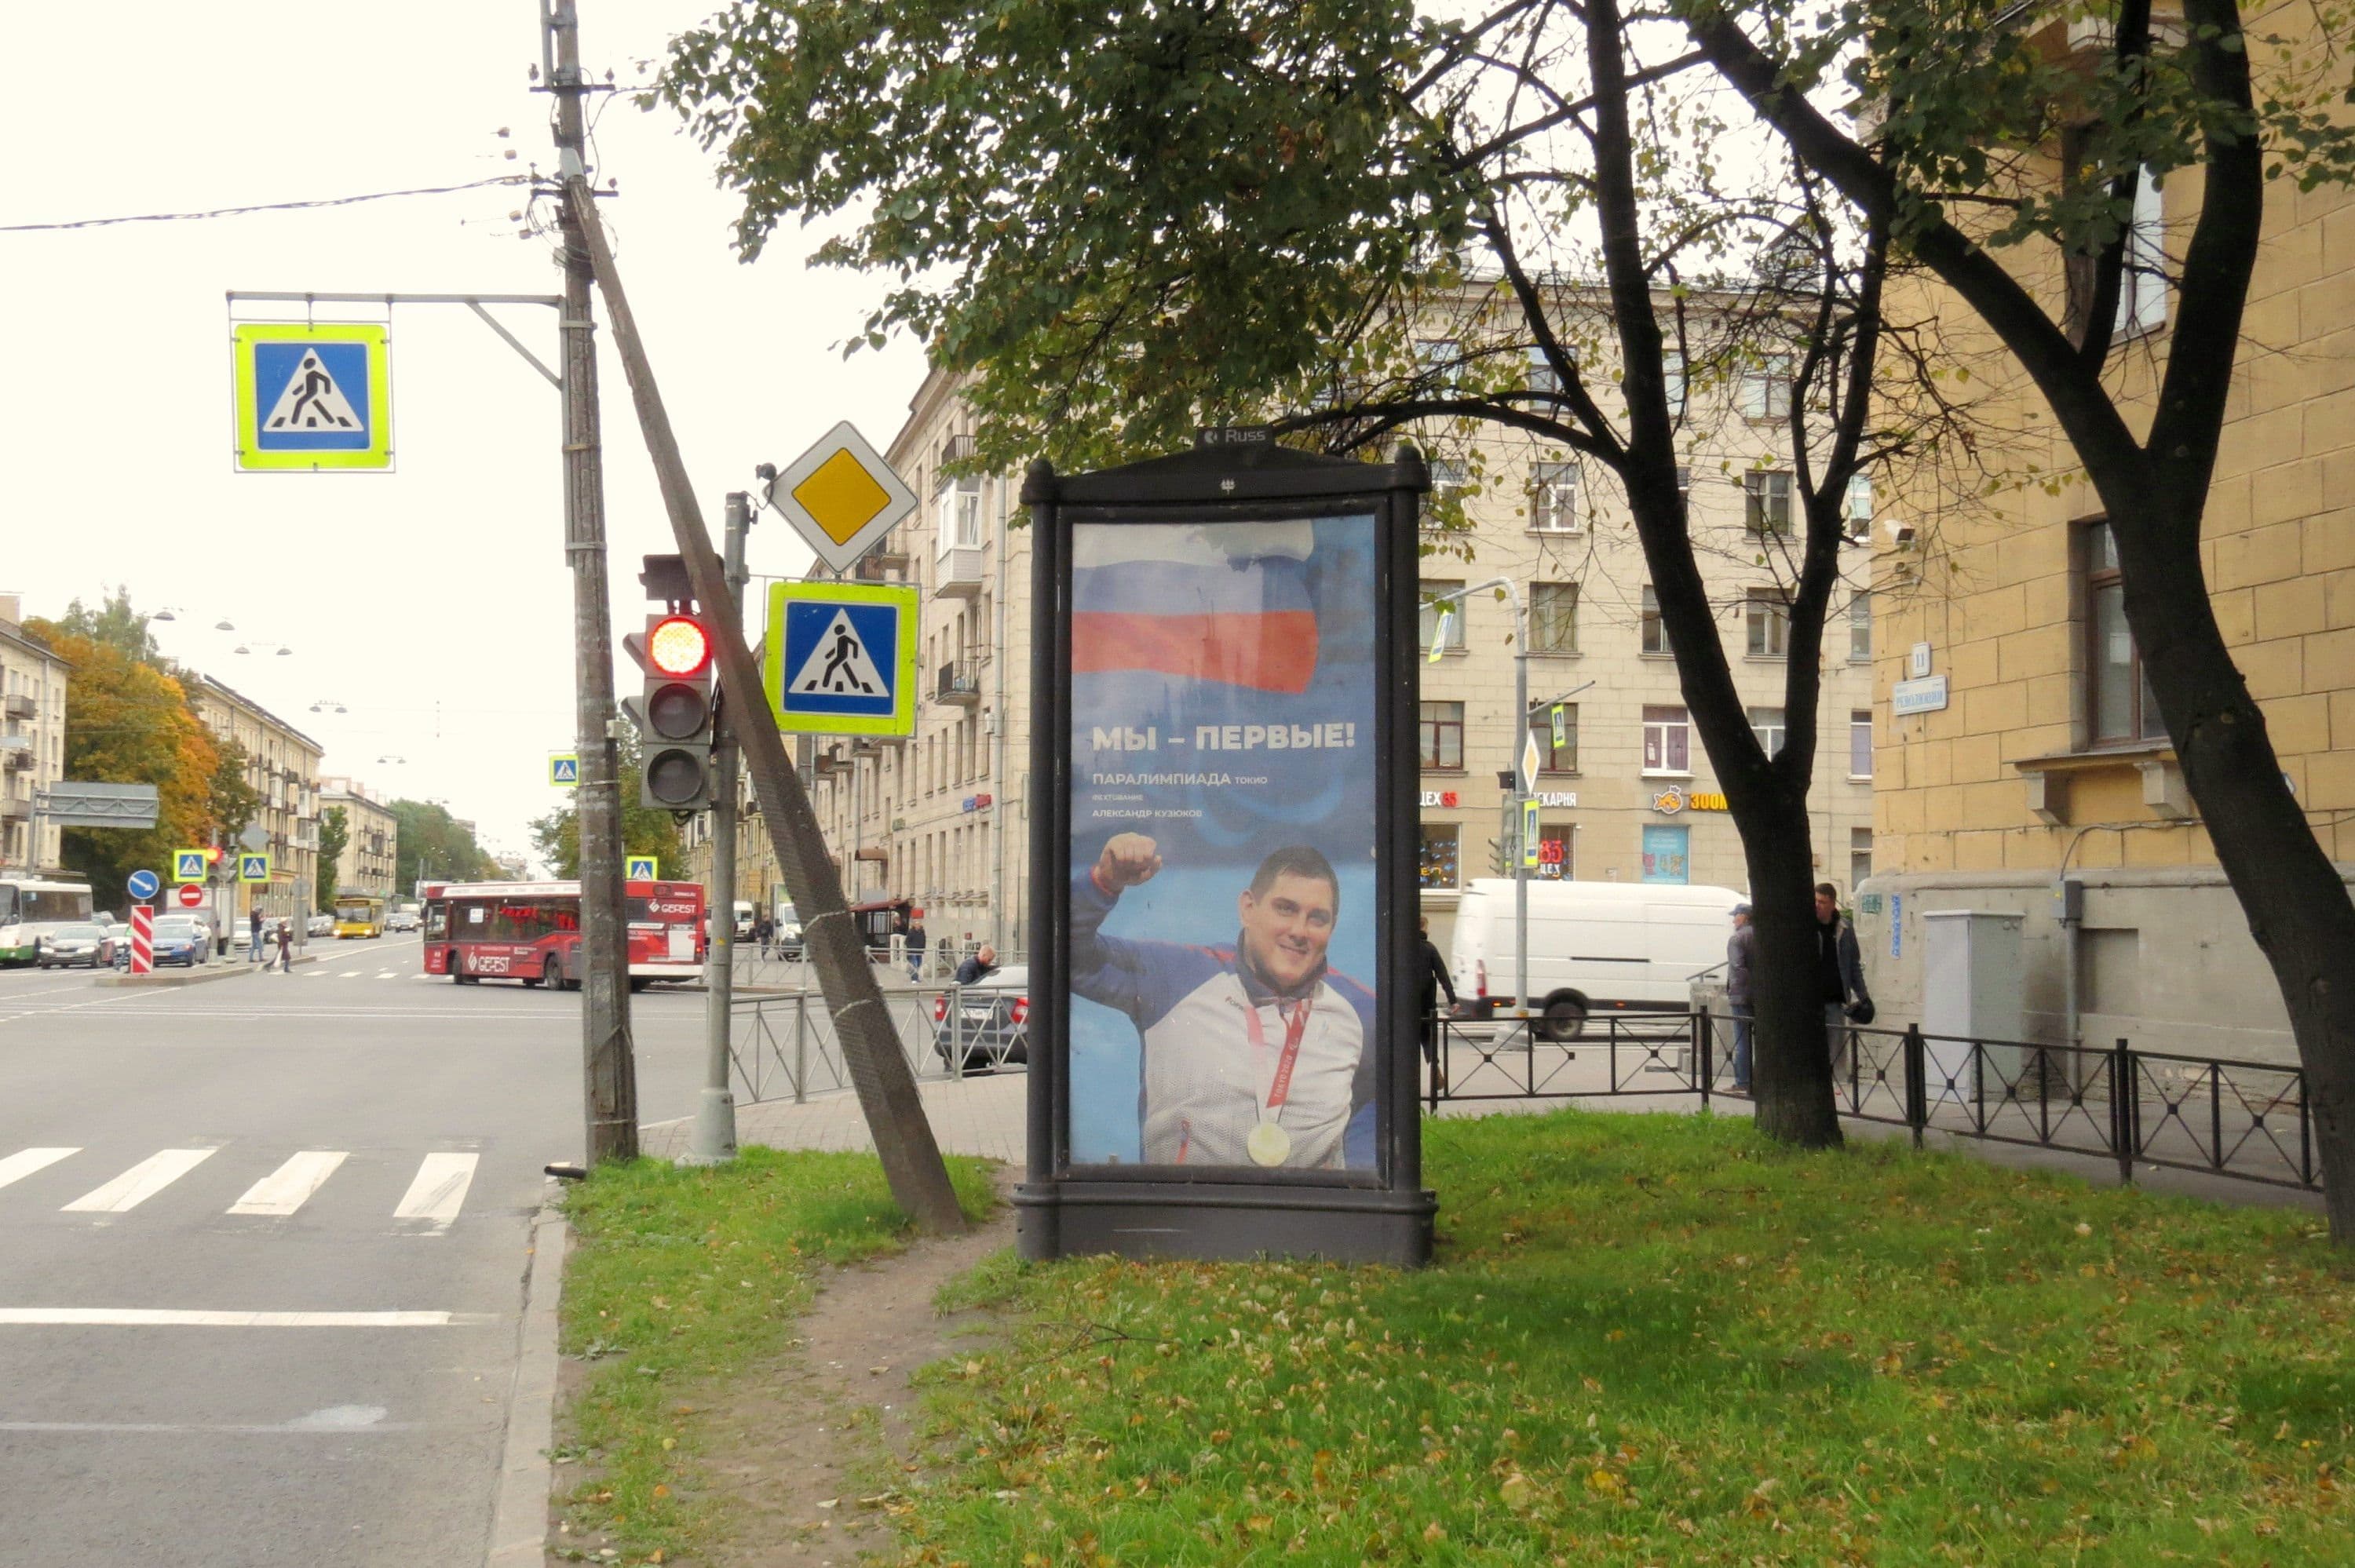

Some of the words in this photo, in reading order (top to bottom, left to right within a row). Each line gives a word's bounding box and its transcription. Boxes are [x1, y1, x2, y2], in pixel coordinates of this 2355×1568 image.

[1225, 429, 1266, 443] Russ
[1092, 726, 1156, 752] МЫ
[1196, 723, 1356, 751] ПЕРВЫЕ!
[1092, 773, 1231, 787] ПАРАЛИМПИАДА
[1235, 775, 1268, 786] ТОКИО
[1092, 809, 1152, 819] АЛЕКСАНДР
[1539, 840, 1563, 863] 85
[661, 904, 696, 913] GEFEST
[478, 956, 510, 972] GEFEST
